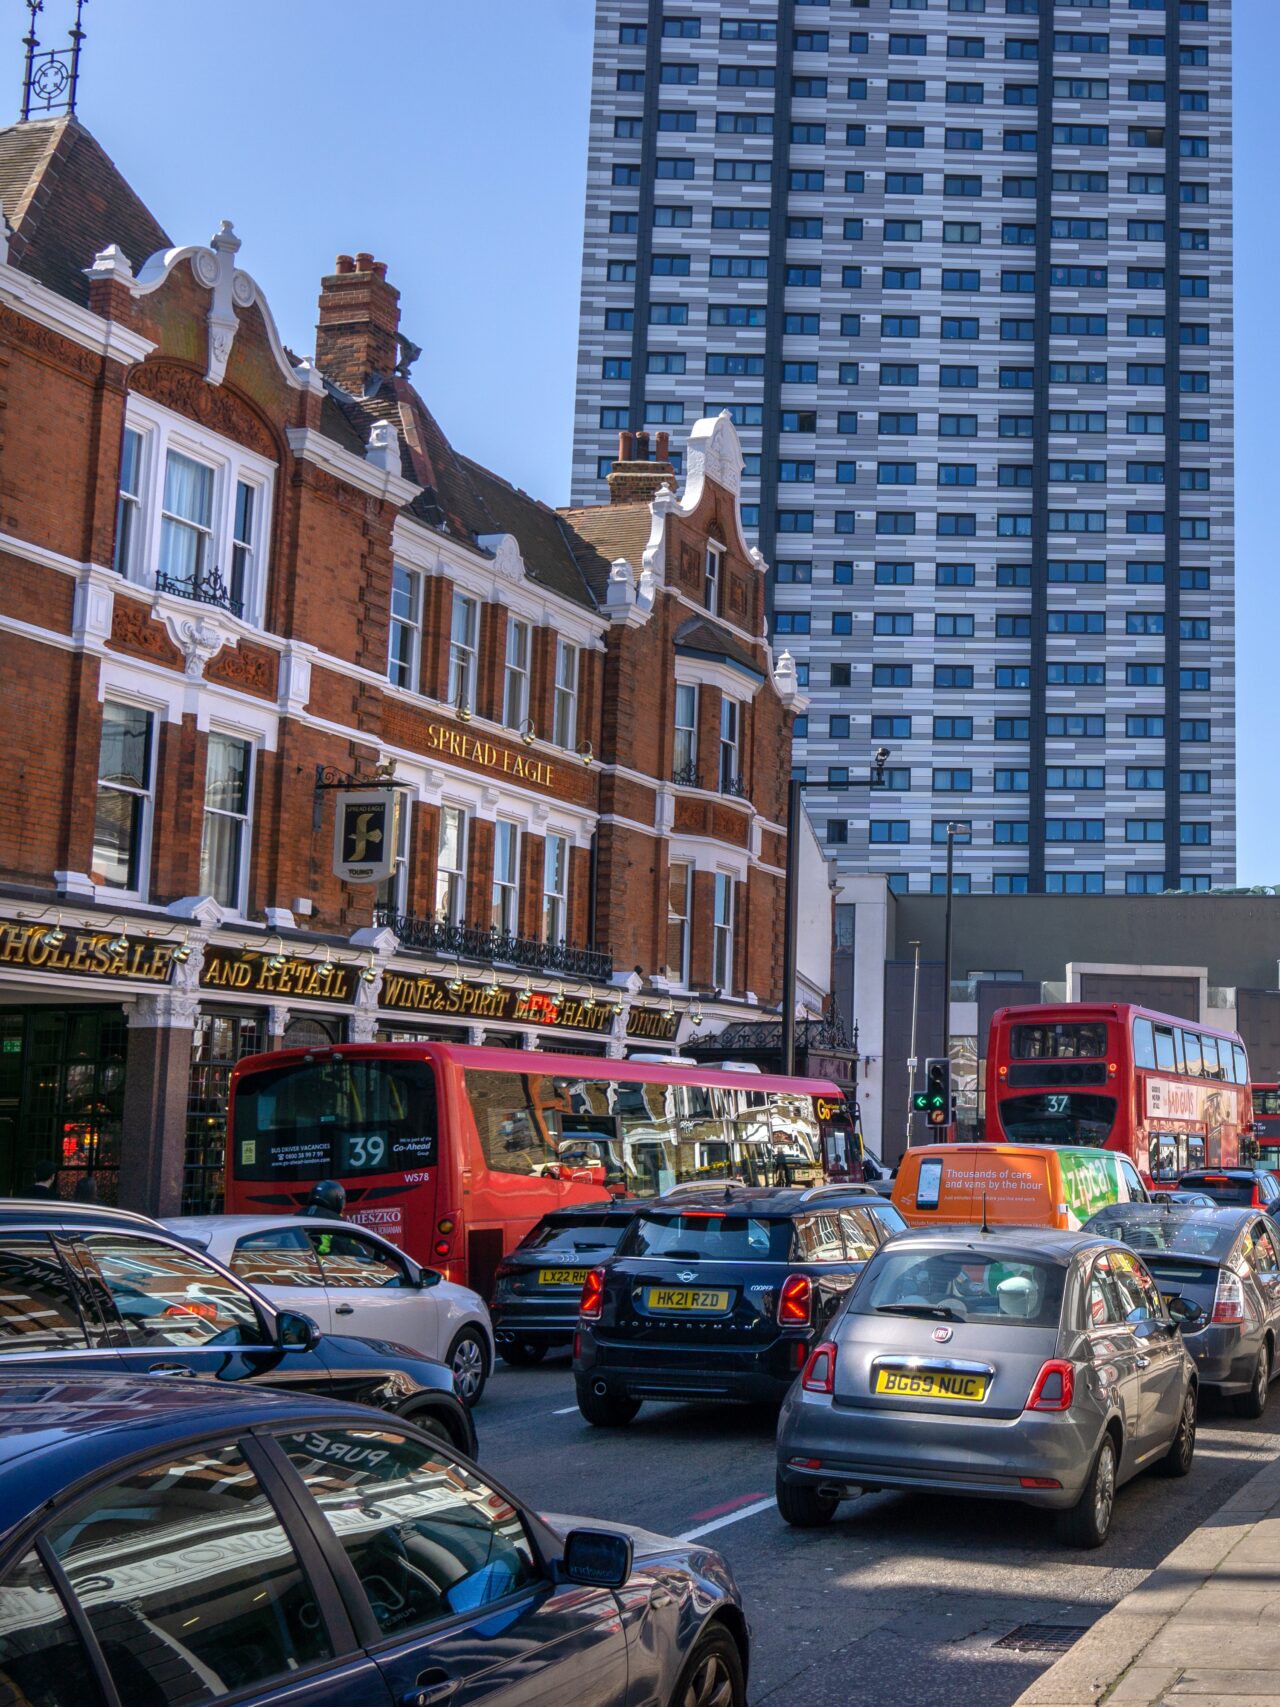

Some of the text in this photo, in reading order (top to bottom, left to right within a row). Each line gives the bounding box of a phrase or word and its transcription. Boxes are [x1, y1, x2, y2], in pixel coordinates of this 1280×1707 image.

[427, 723, 555, 787] SPREAD EAGLE
[203, 957, 348, 999] AND RETAIL
[514, 994, 612, 1028] MERCHANT
[627, 1006, 676, 1038] DINING
[1047, 1095, 1069, 1112] 37
[300, 1143, 331, 1151] VACANCIES
[349, 1136, 385, 1167] 39
[393, 1142, 432, 1153] Go-Ahead
[404, 1173, 430, 1183] WS78
[945, 1169, 1032, 1179] Thousands of cars
[945, 1179, 1043, 1191] and vans by the hour
[1066, 1157, 1113, 1216] zipcar
[346, 1211, 401, 1225] MIESZKO
[543, 1271, 571, 1282] LX22
[656, 1290, 720, 1307] HK21 RZD
[619, 1320, 753, 1330] COUNTRYMAN
[884, 1374, 977, 1396] BG69 NUC
